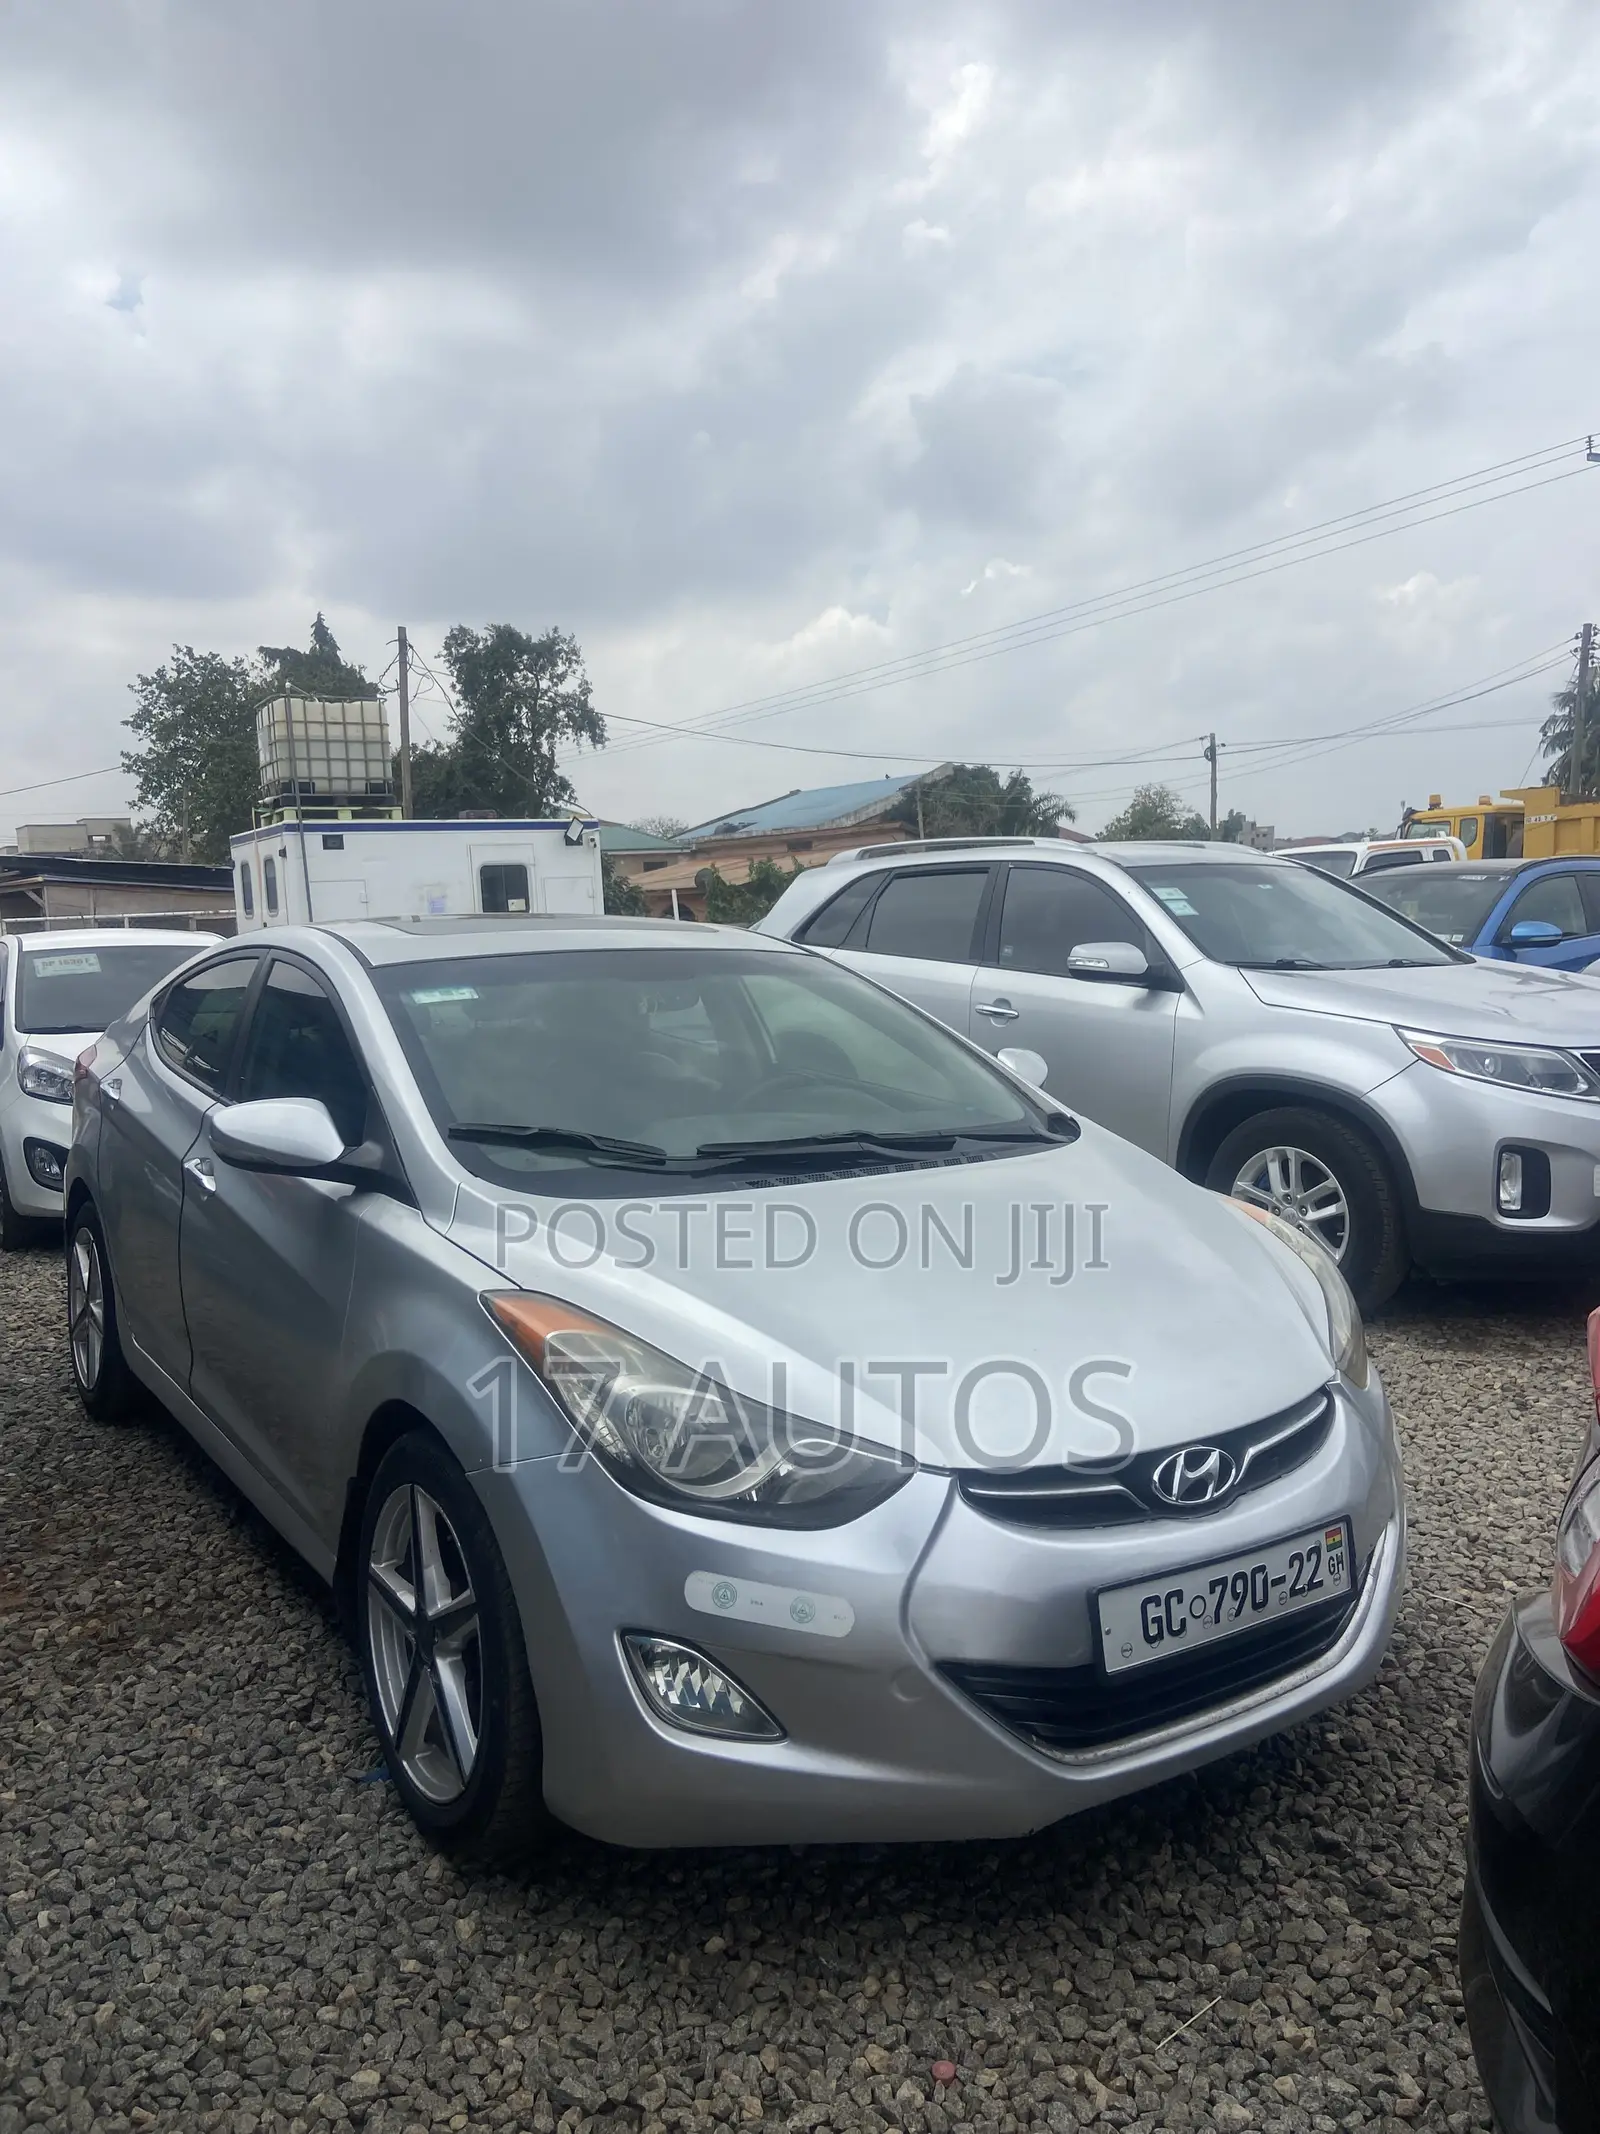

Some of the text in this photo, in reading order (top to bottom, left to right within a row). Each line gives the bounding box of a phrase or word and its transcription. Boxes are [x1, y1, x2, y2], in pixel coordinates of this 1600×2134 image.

[1328, 1551, 1345, 1576] GH
[1140, 1545, 1324, 1645] GC 790-22
